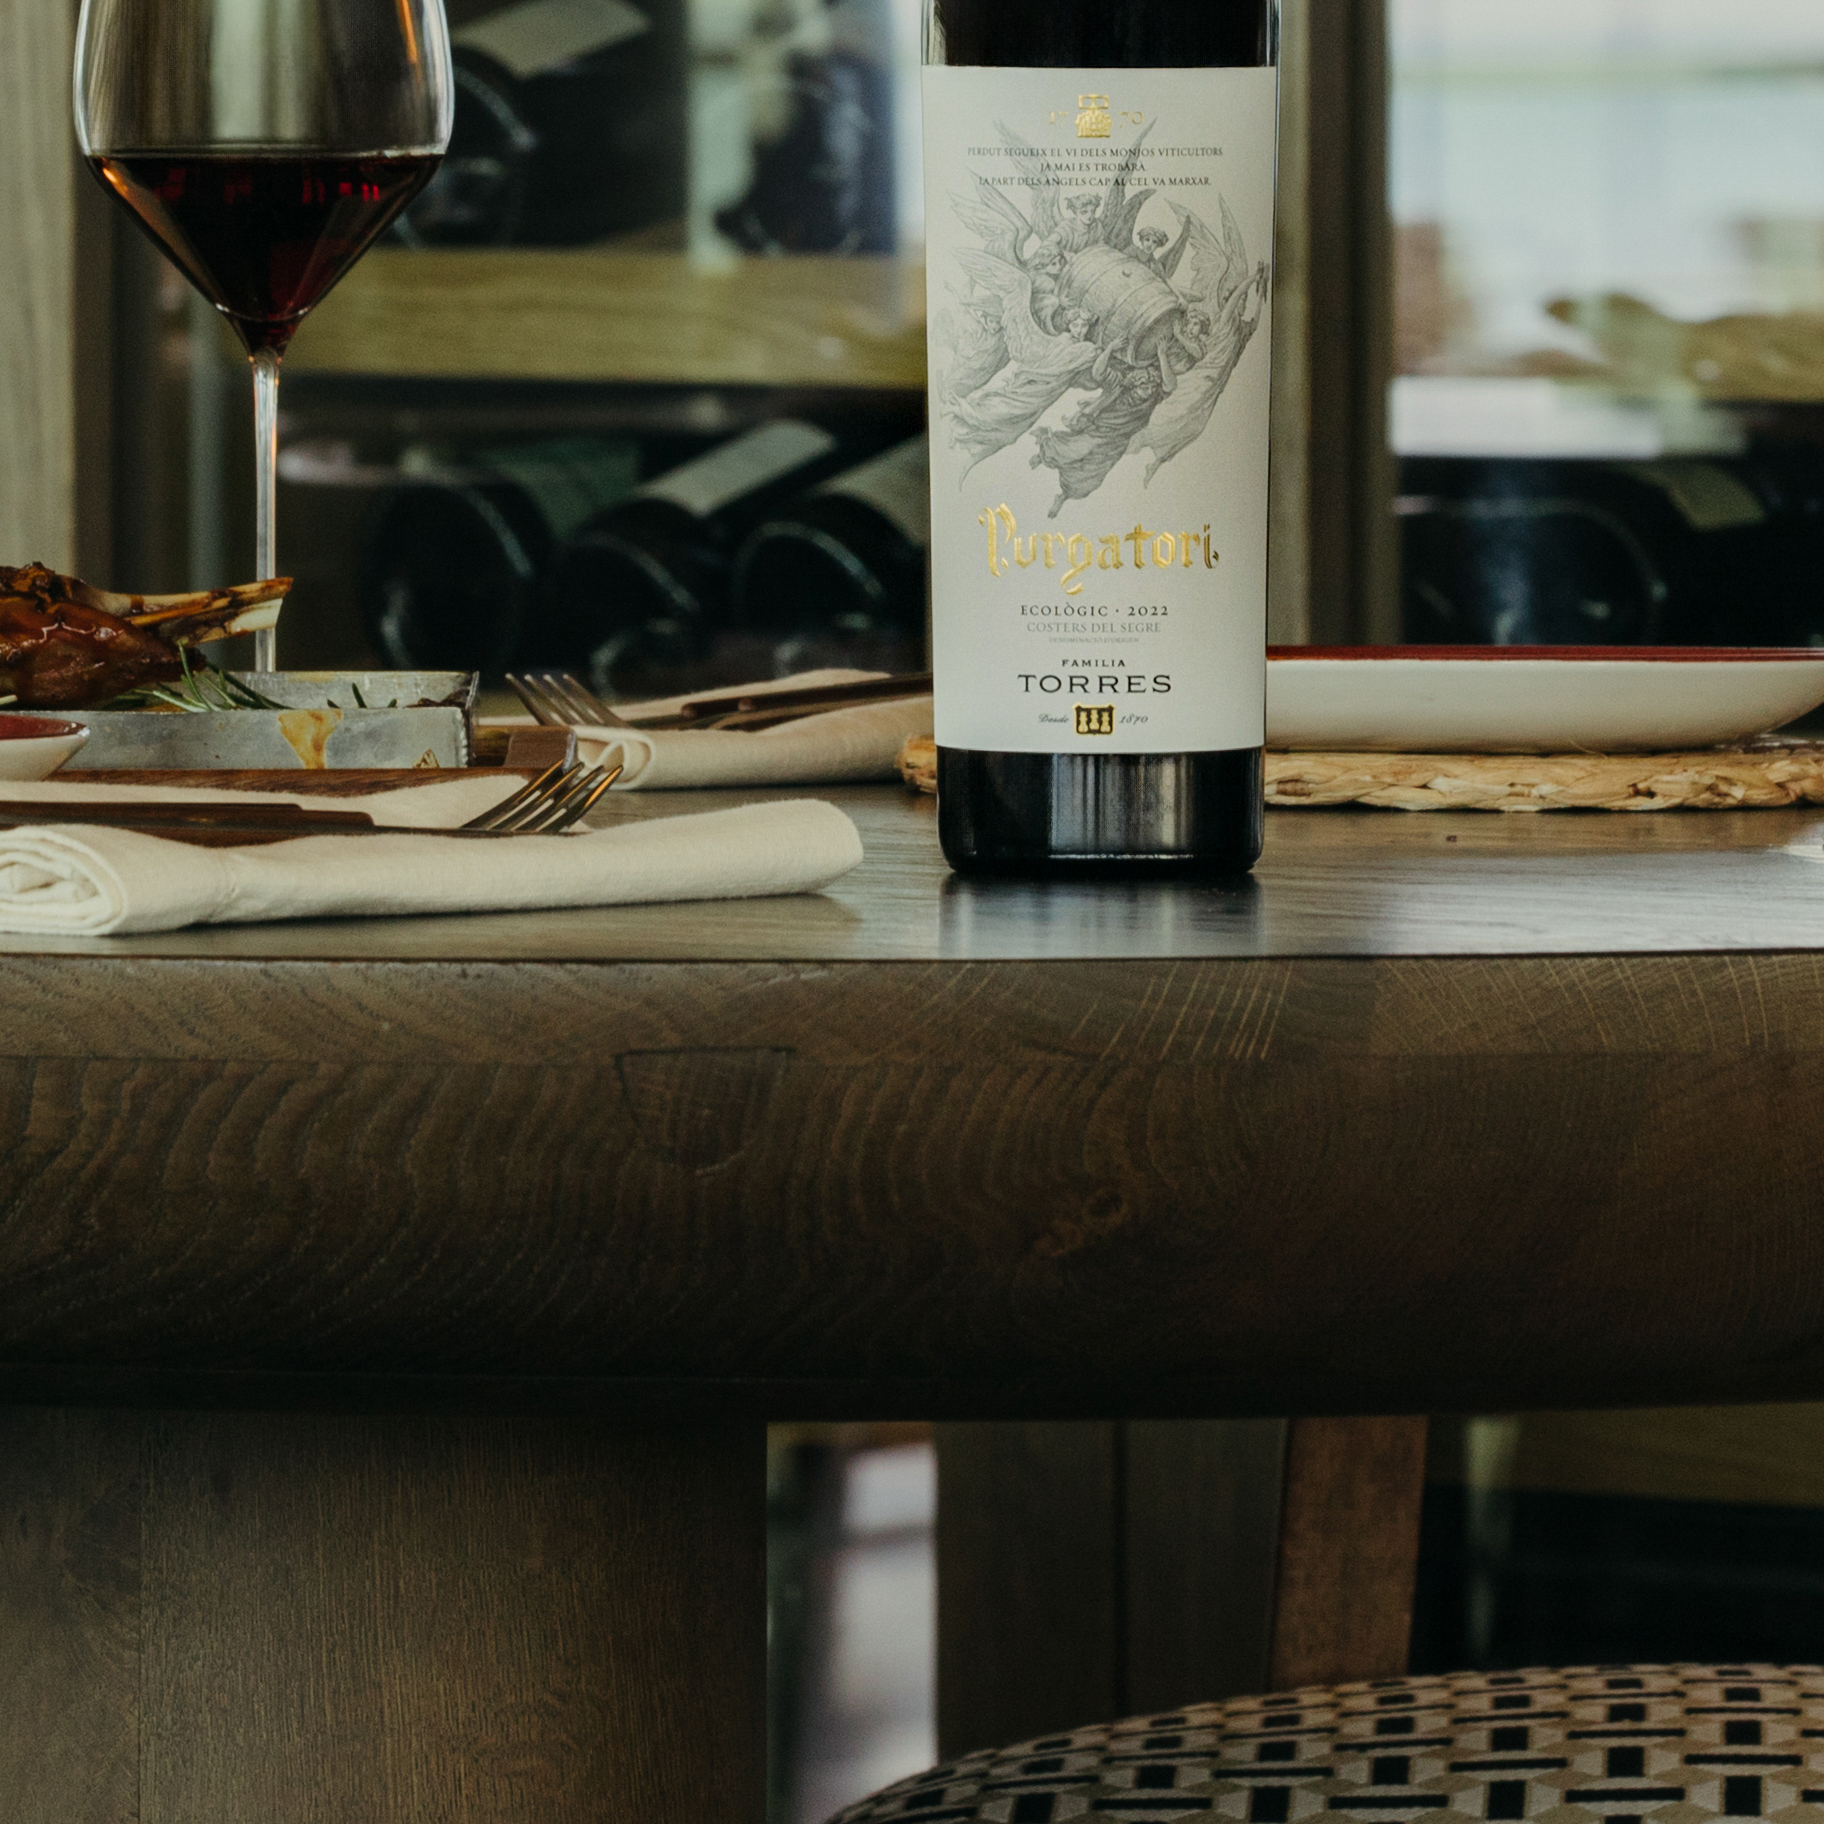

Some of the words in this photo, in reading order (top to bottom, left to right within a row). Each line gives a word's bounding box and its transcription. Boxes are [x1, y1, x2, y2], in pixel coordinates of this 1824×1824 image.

[1118, 110, 1144, 129] 70
[967, 146, 1003, 157] PERDUT
[1004, 147, 1047, 157] SEGUEIX
[1050, 147, 1062, 157] EL
[1065, 147, 1078, 157] VI
[1080, 147, 1107, 157] DELS
[1110, 147, 1155, 159] MONJOS
[1158, 146, 1224, 157] VITICULTORS
[1040, 162, 1052, 174] JA
[1054, 162, 1076, 172] MAI
[1078, 162, 1091, 172] ES
[1093, 160, 1146, 172] TROBARÀ
[978, 177, 990, 187] LA
[991, 177, 1016, 187] PART
[1017, 177, 1043, 187] DELS
[1089, 177, 1111, 187] CAP
[1112, 177, 1127, 187] AL
[1129, 177, 1150, 187] CEL
[1152, 177, 1167, 187] VA
[1168, 176, 1212, 187] MARXAR
[977, 502, 1220, 596] Purgatori
[1020, 601, 1109, 617] ECOLÒGIC
[1126, 605, 1169, 617] 2022
[1026, 622, 1087, 633] COSTERS
[1091, 622, 1118, 633] DEL
[1120, 622, 1162, 633] SEGRE
[1061, 659, 1127, 668] FAMILIA
[1017, 674, 1172, 694] TORRES
[1037, 713, 1070, 724] Desde
[1118, 713, 1149, 726] 1870
